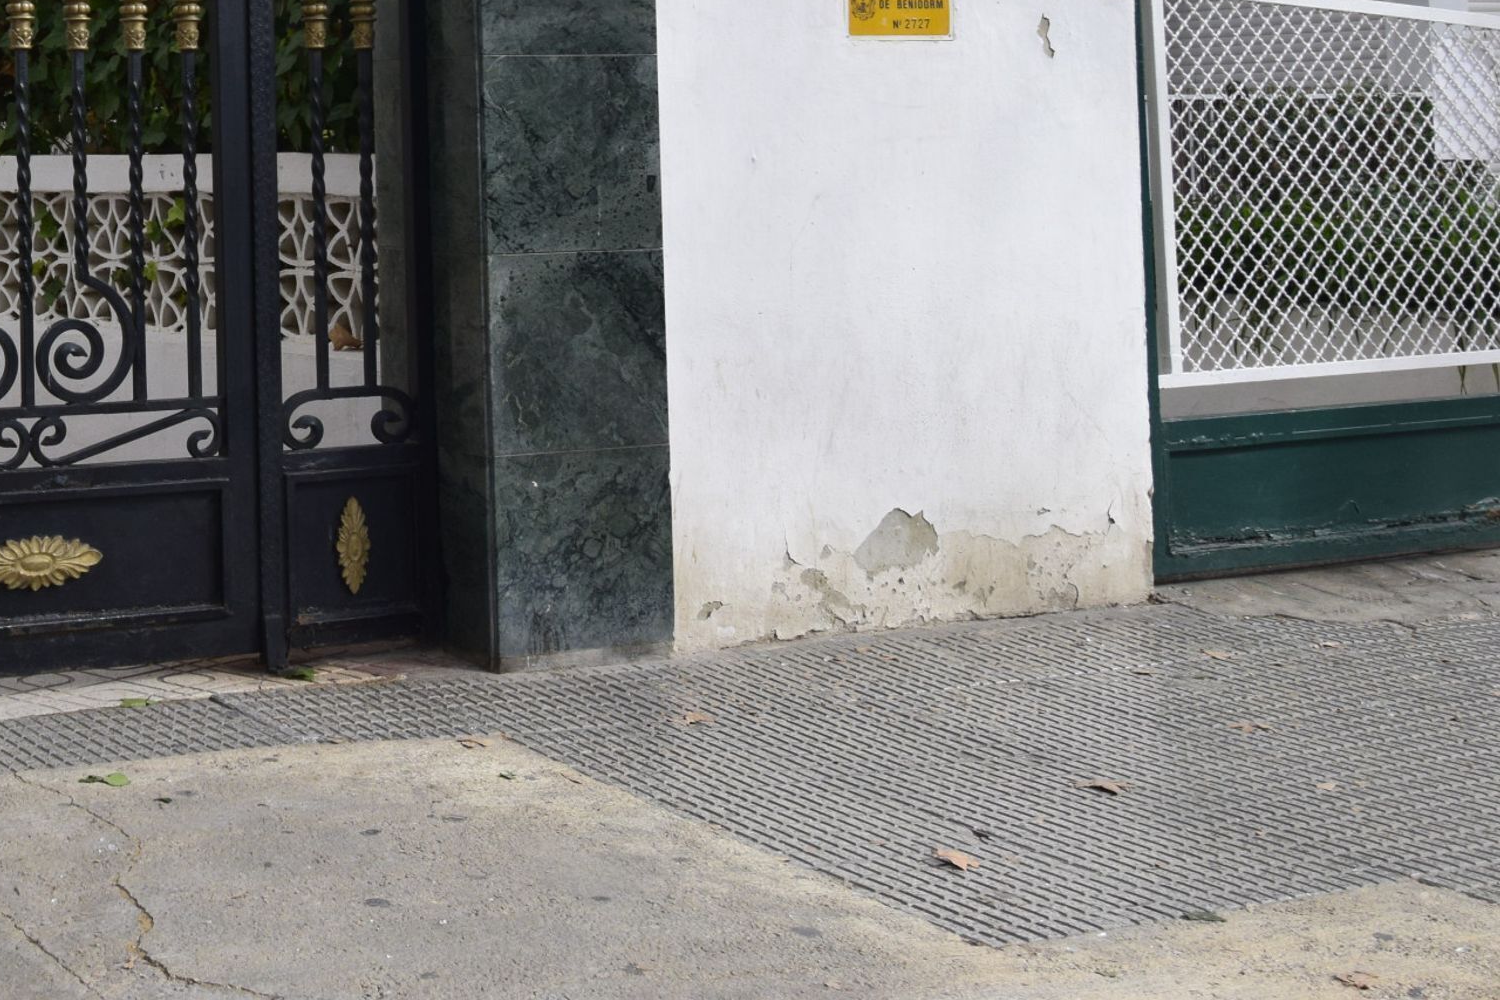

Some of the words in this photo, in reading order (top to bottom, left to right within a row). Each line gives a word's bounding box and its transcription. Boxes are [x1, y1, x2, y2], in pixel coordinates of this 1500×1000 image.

[878, 0, 891, 9] DE
[896, 0, 944, 9] BENIDORM
[904, 18, 931, 29] 2727
